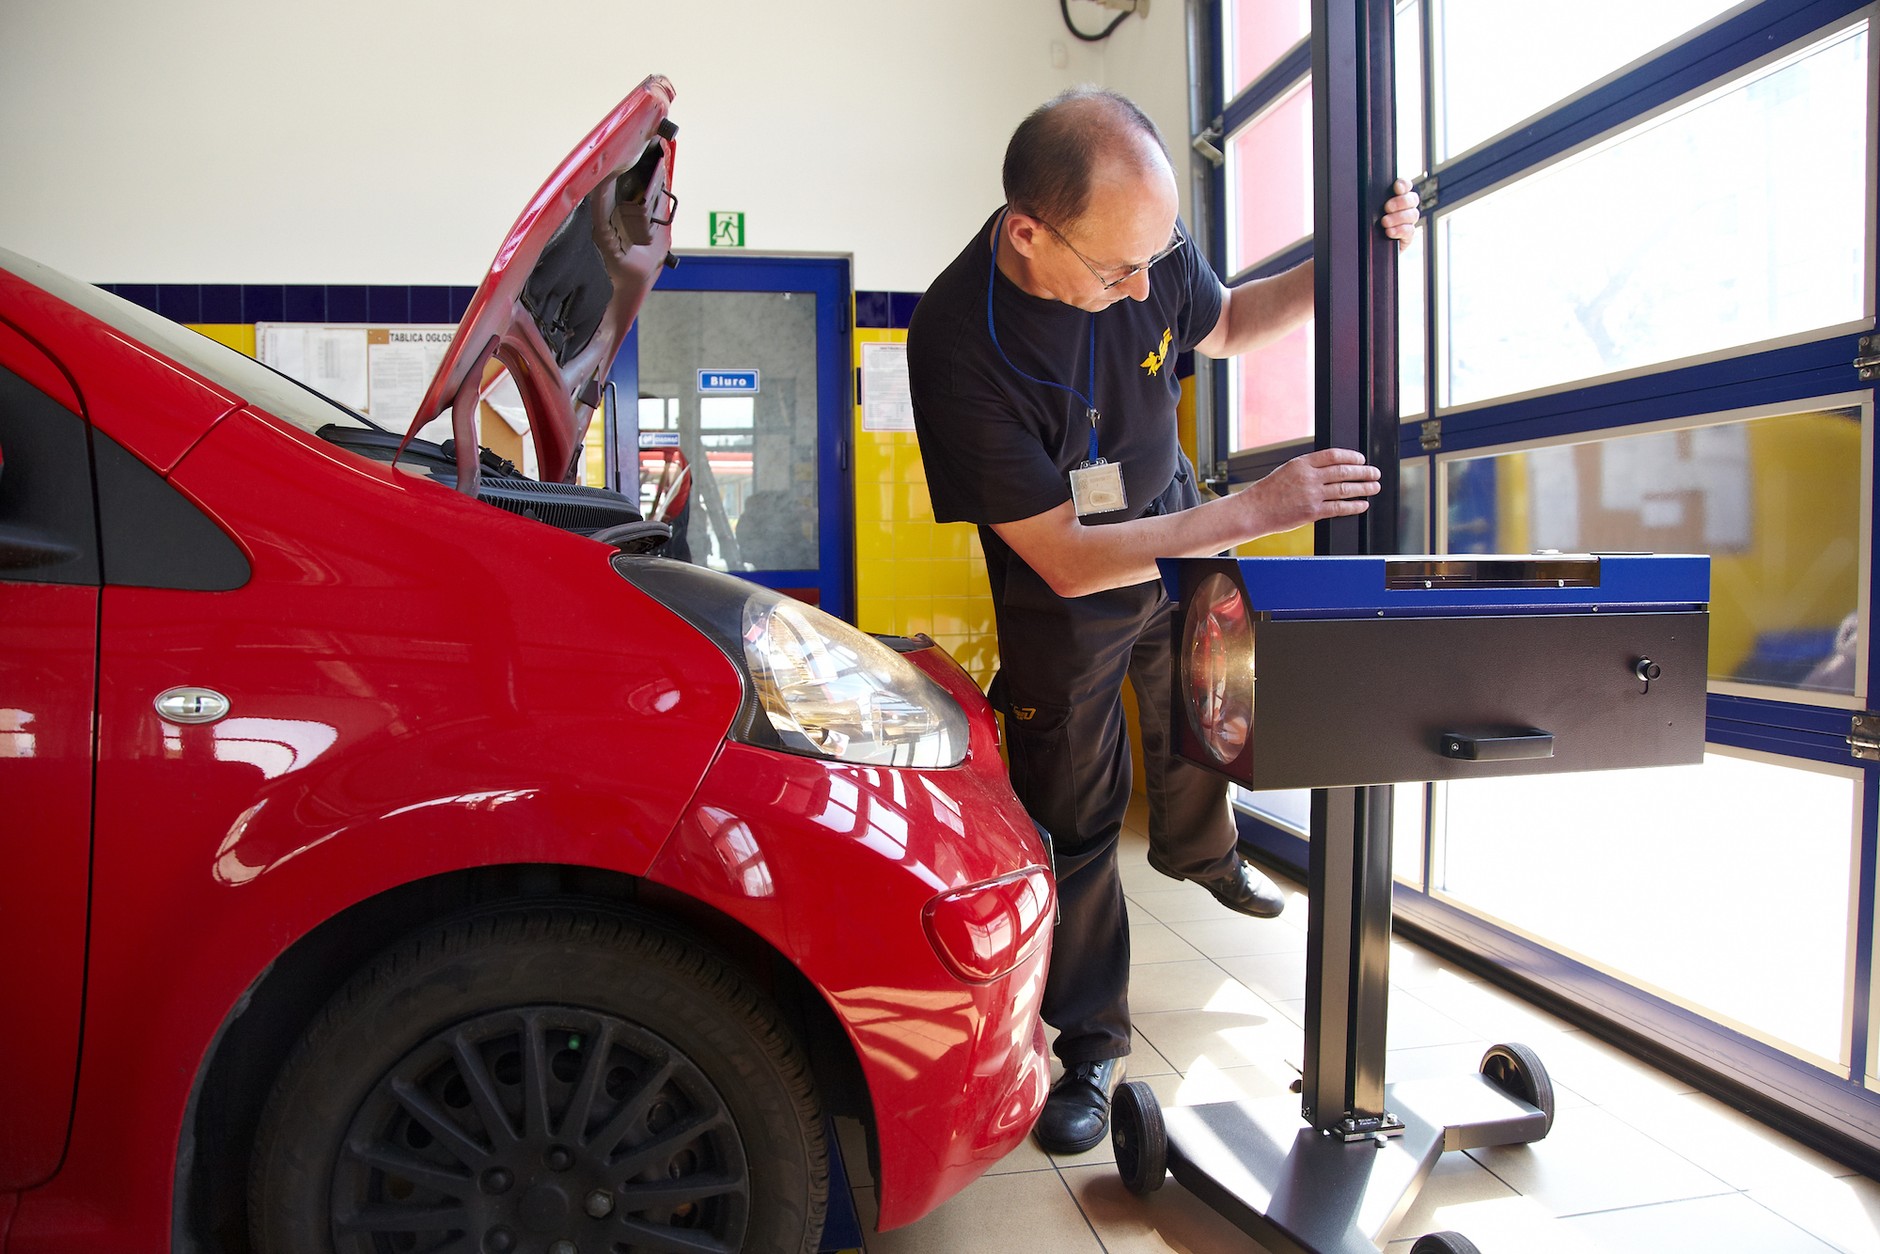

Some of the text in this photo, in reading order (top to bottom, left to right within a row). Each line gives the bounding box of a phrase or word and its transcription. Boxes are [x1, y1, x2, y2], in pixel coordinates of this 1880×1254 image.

[389, 332, 455, 343] TABLICA OGŁOS
[710, 375, 747, 387] Biuro
